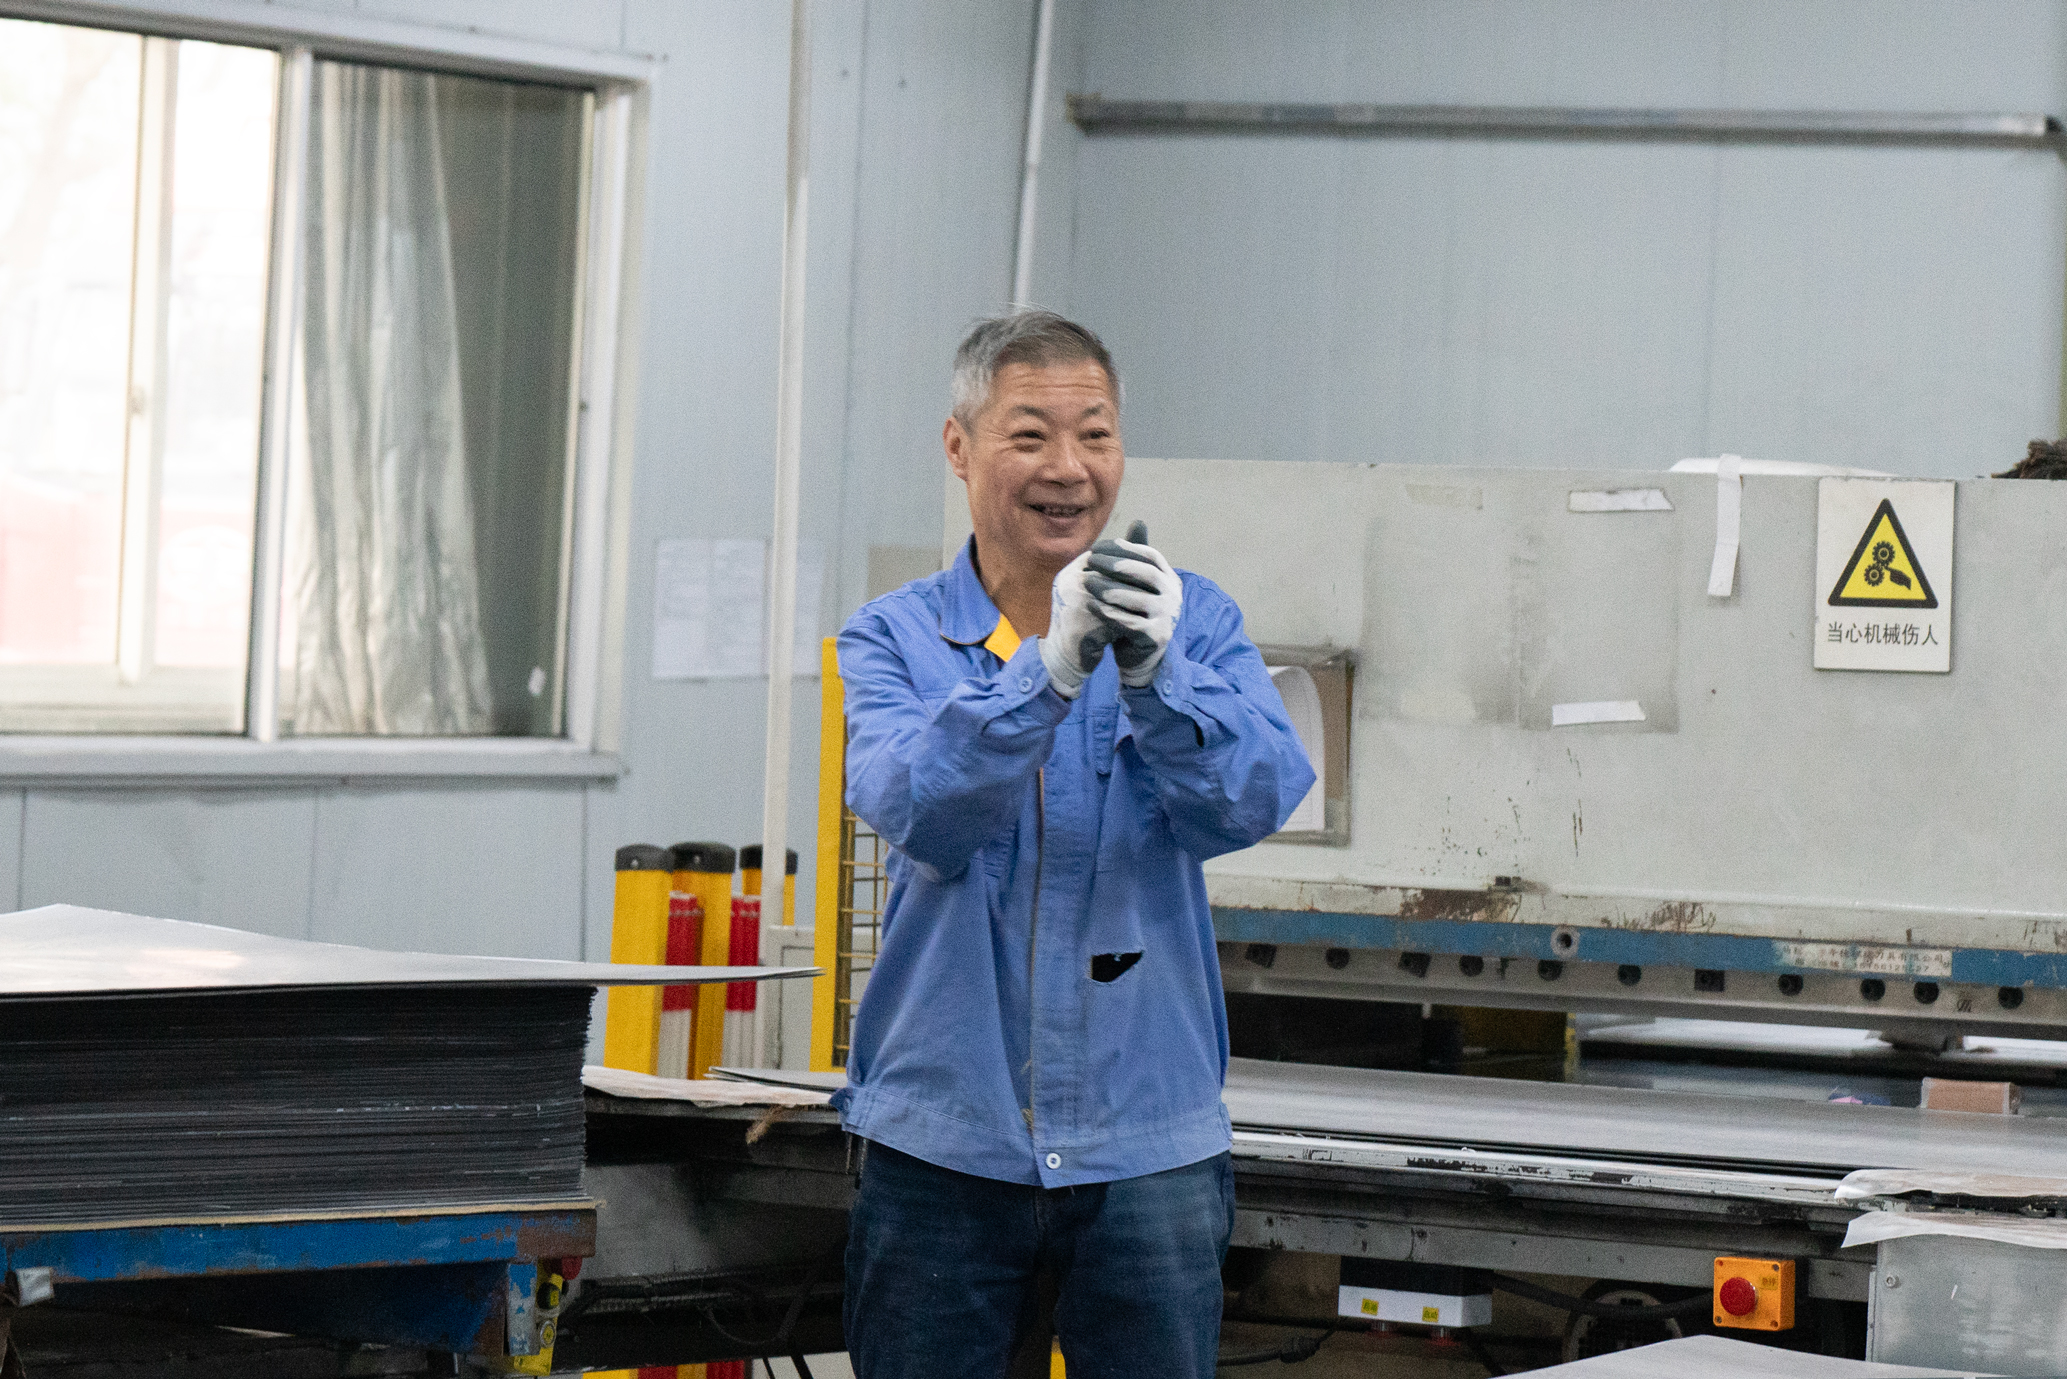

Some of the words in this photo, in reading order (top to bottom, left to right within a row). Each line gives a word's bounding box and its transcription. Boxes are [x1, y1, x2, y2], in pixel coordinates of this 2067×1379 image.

[1827, 620, 1939, 646] 当心机械伤人
